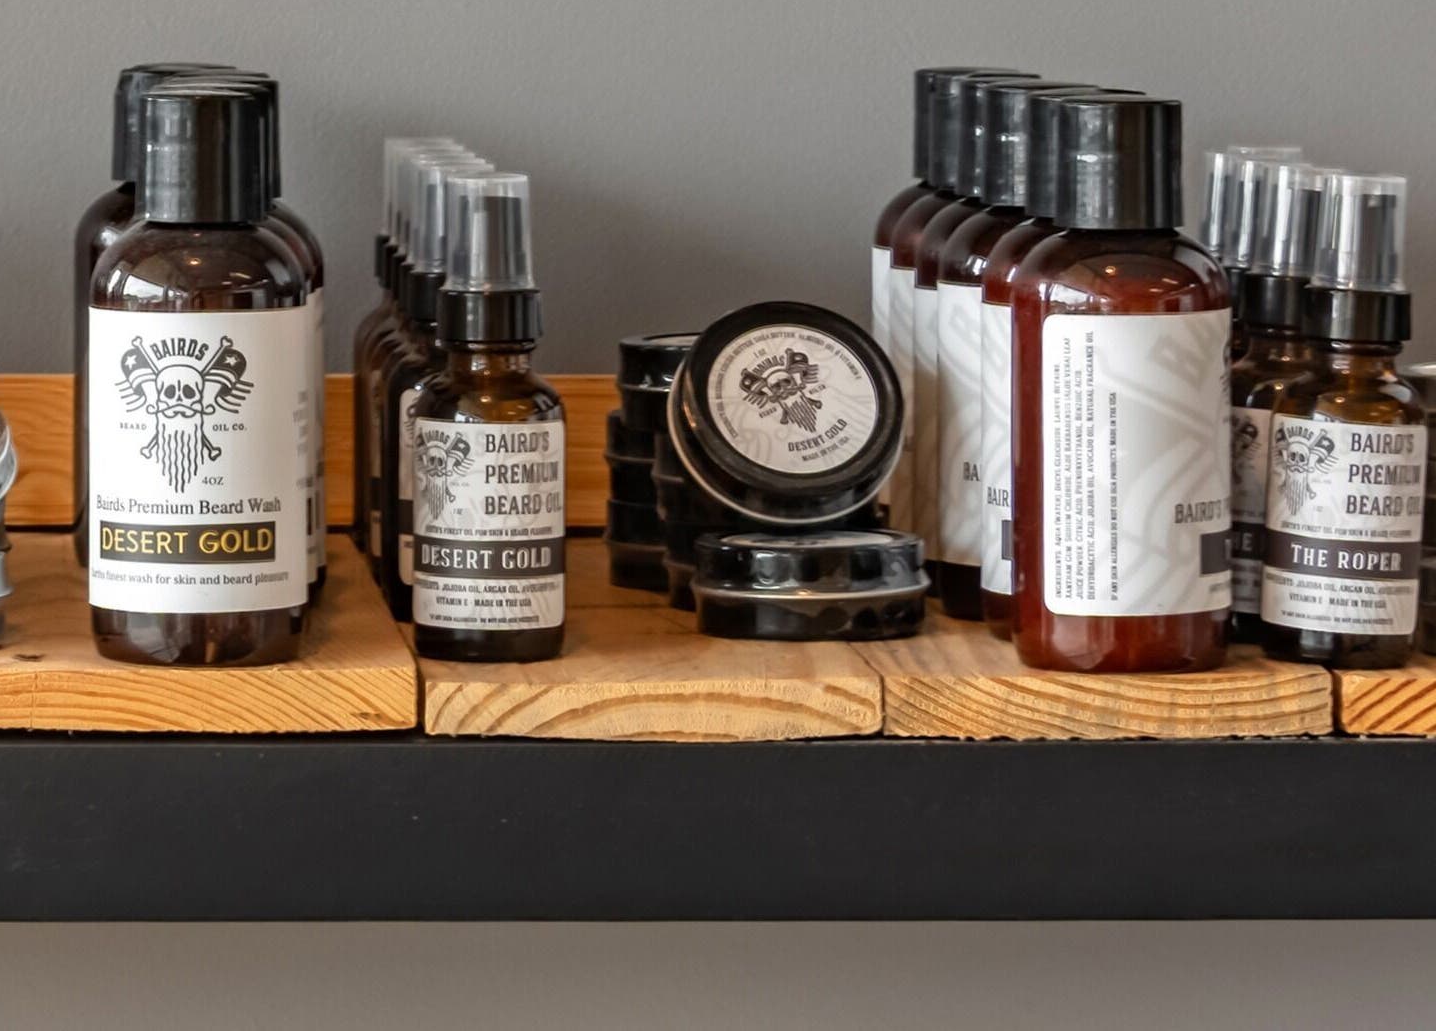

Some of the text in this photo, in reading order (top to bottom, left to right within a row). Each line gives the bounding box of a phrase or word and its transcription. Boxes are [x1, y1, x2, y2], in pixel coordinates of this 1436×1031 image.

[1086, 332, 1095, 343] OIL
[150, 338, 209, 361] BAIRDS
[1086, 389, 1095, 421] NATURAL
[120, 422, 146, 430] BEARD
[788, 418, 848, 452] DESERT GOLD
[485, 431, 550, 453] BAIRD'S
[1351, 432, 1414, 455] BAIRD'S
[1086, 439, 1095, 472] AVOCADO
[202, 476, 224, 486] 4OZ
[485, 461, 559, 484] PREMIUM
[1348, 464, 1422, 486] PREMIUM
[96, 494, 281, 514] Bairds Premium Beard Wash
[485, 492, 562, 515] BEARD OIL
[988, 486, 1009, 507] BAIR
[1346, 494, 1404, 516] BEARD
[102, 527, 273, 554] DESERT GOLD
[421, 544, 552, 570] DESERT GOLD
[1291, 543, 1401, 570] THE ROPER
[128, 572, 152, 584] wash
[155, 573, 170, 584] for
[174, 574, 196, 585] skin
[200, 574, 220, 585] and
[223, 574, 252, 584] beard
